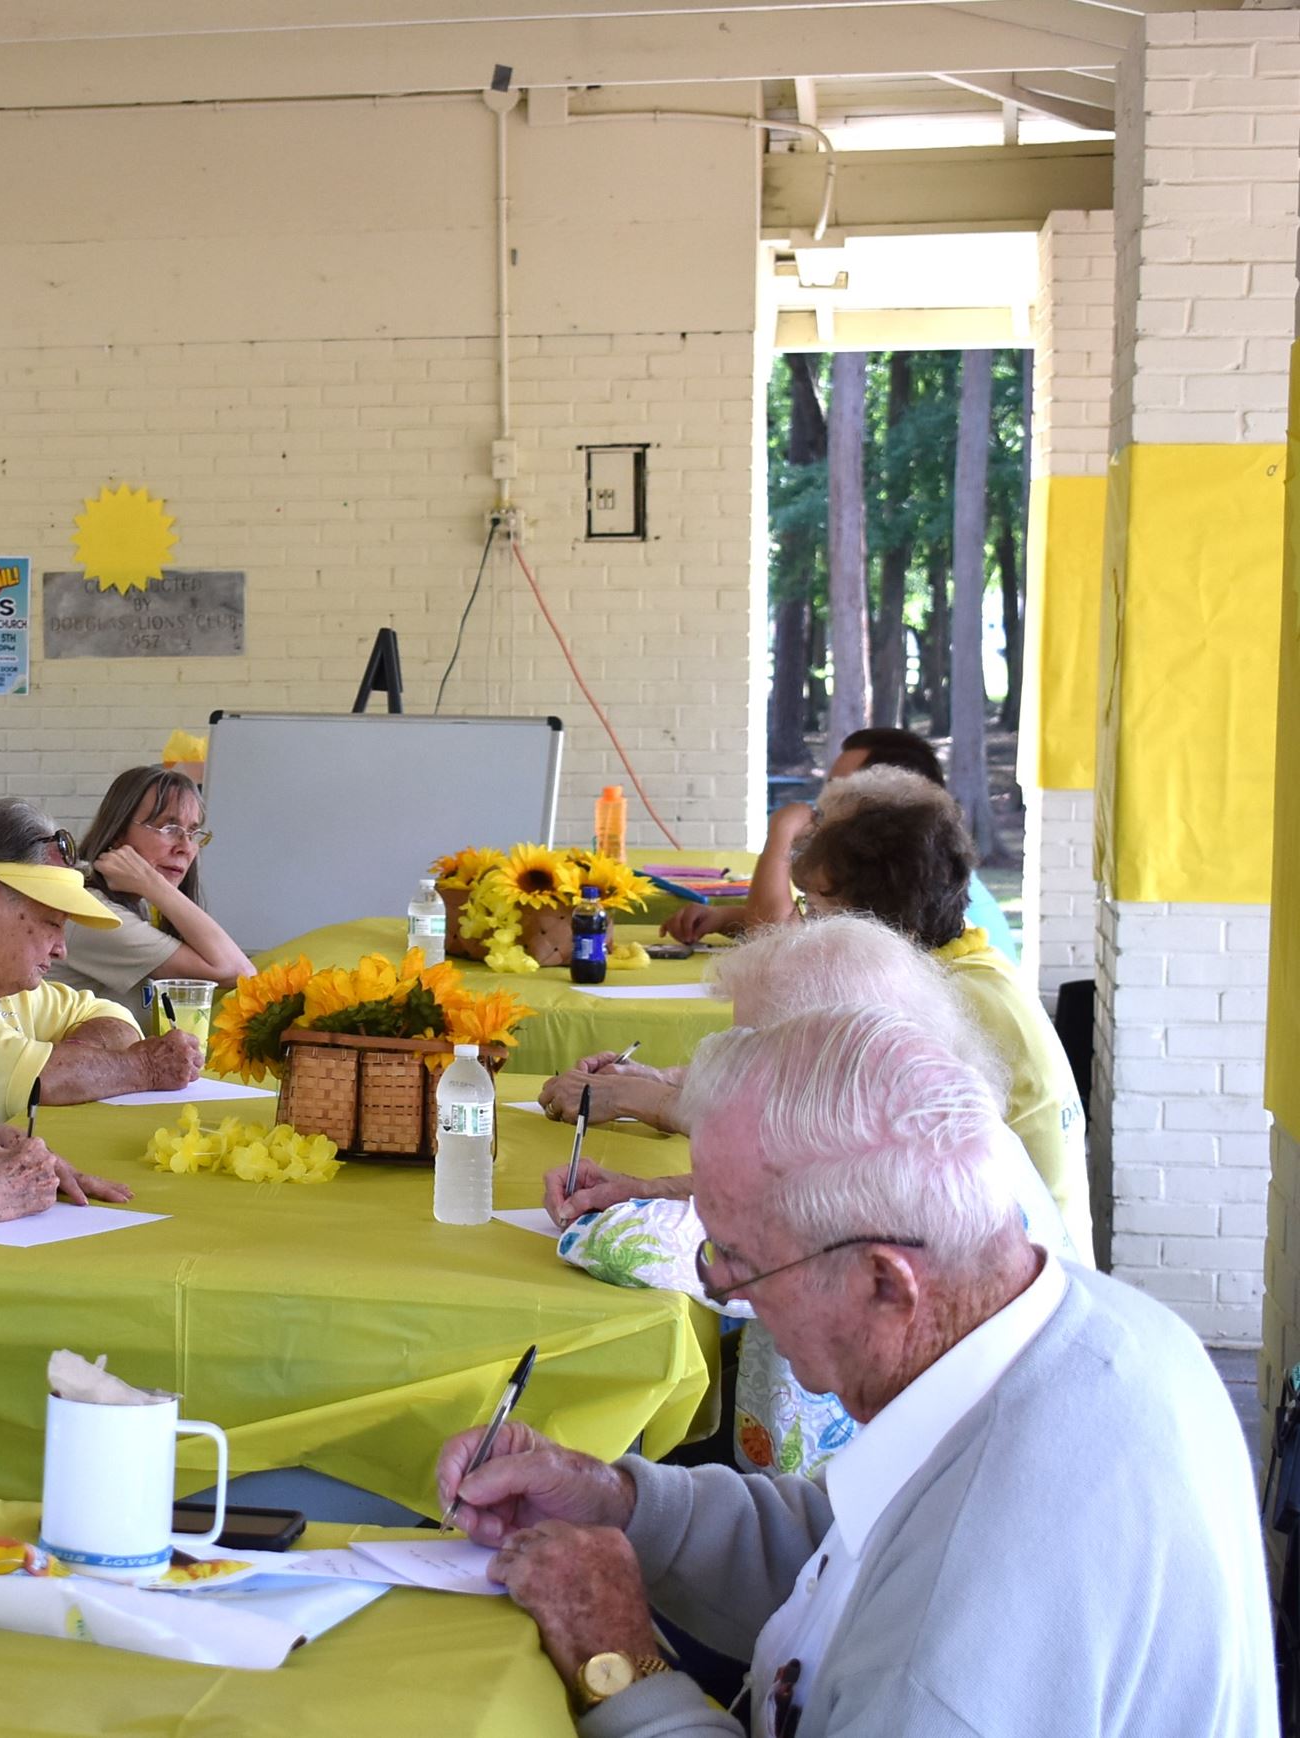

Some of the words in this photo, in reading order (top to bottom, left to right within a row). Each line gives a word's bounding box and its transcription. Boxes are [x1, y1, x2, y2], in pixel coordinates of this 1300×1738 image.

[134, 598, 152, 612] BY
[138, 615, 185, 630] LIONS
[98, 1555, 158, 1567] Loves
